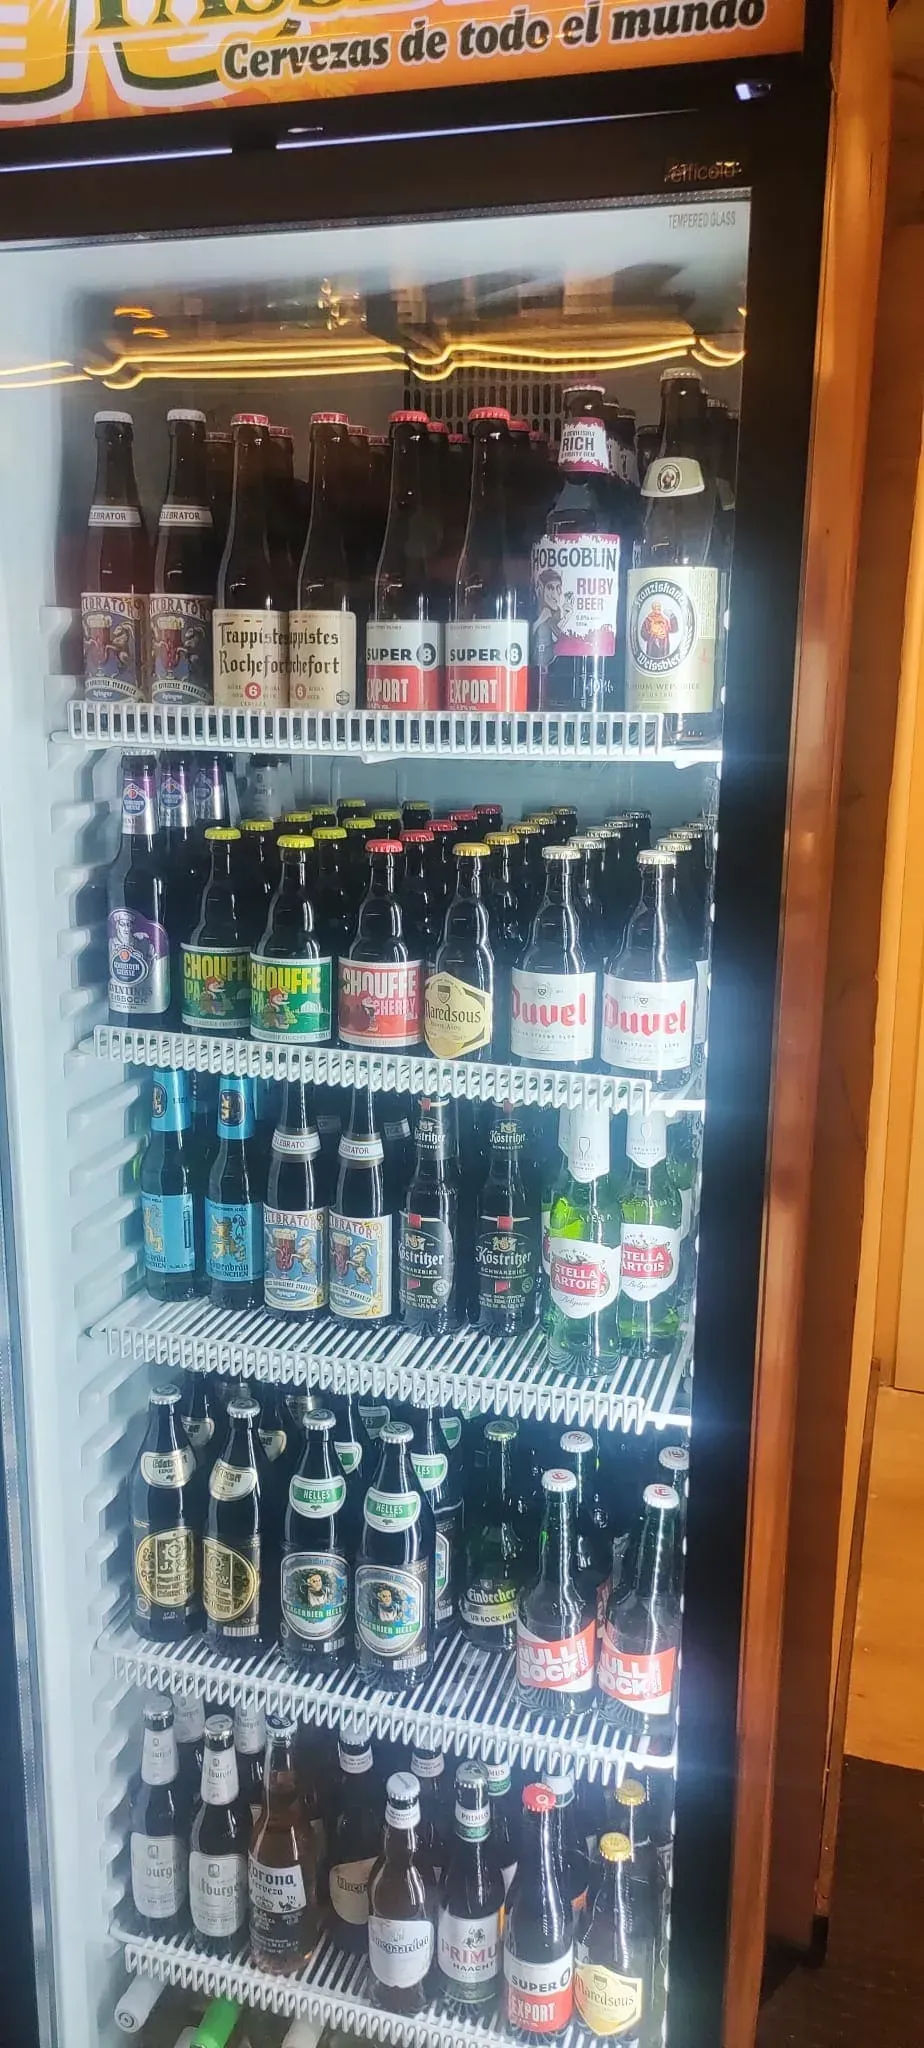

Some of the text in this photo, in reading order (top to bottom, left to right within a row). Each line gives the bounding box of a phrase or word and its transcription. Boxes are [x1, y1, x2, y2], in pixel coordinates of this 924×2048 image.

[225, 0, 765, 81] Cervezas de todo el mundo
[669, 210, 736, 229] TEMPERED GLASS
[562, 437, 594, 451] RICH
[533, 547, 616, 572] HOBGOBLIN
[577, 578, 613, 595] RUBY
[577, 597, 603, 611] BEER
[368, 648, 412, 661] SUPER
[450, 648, 500, 661] SUPER
[367, 678, 409, 704] EXPORT
[450, 679, 498, 704] EXPORT
[184, 951, 249, 984] CHOUFF
[252, 962, 321, 995] CHOUFFE
[184, 978, 200, 1003] IPA
[605, 993, 687, 1036] Duvel
[622, 1249, 662, 1261] TELLA
[557, 1264, 598, 1277] STELLA
[555, 1275, 599, 1290] ARTOIS
[303, 1490, 331, 1500] HELLES
[375, 1502, 404, 1514] HELLES
[598, 1671, 646, 1696] OCK
[441, 1938, 497, 1963] PRIMU
[511, 1974, 557, 1992] SUPER
[510, 1994, 556, 2022] EXPORT
